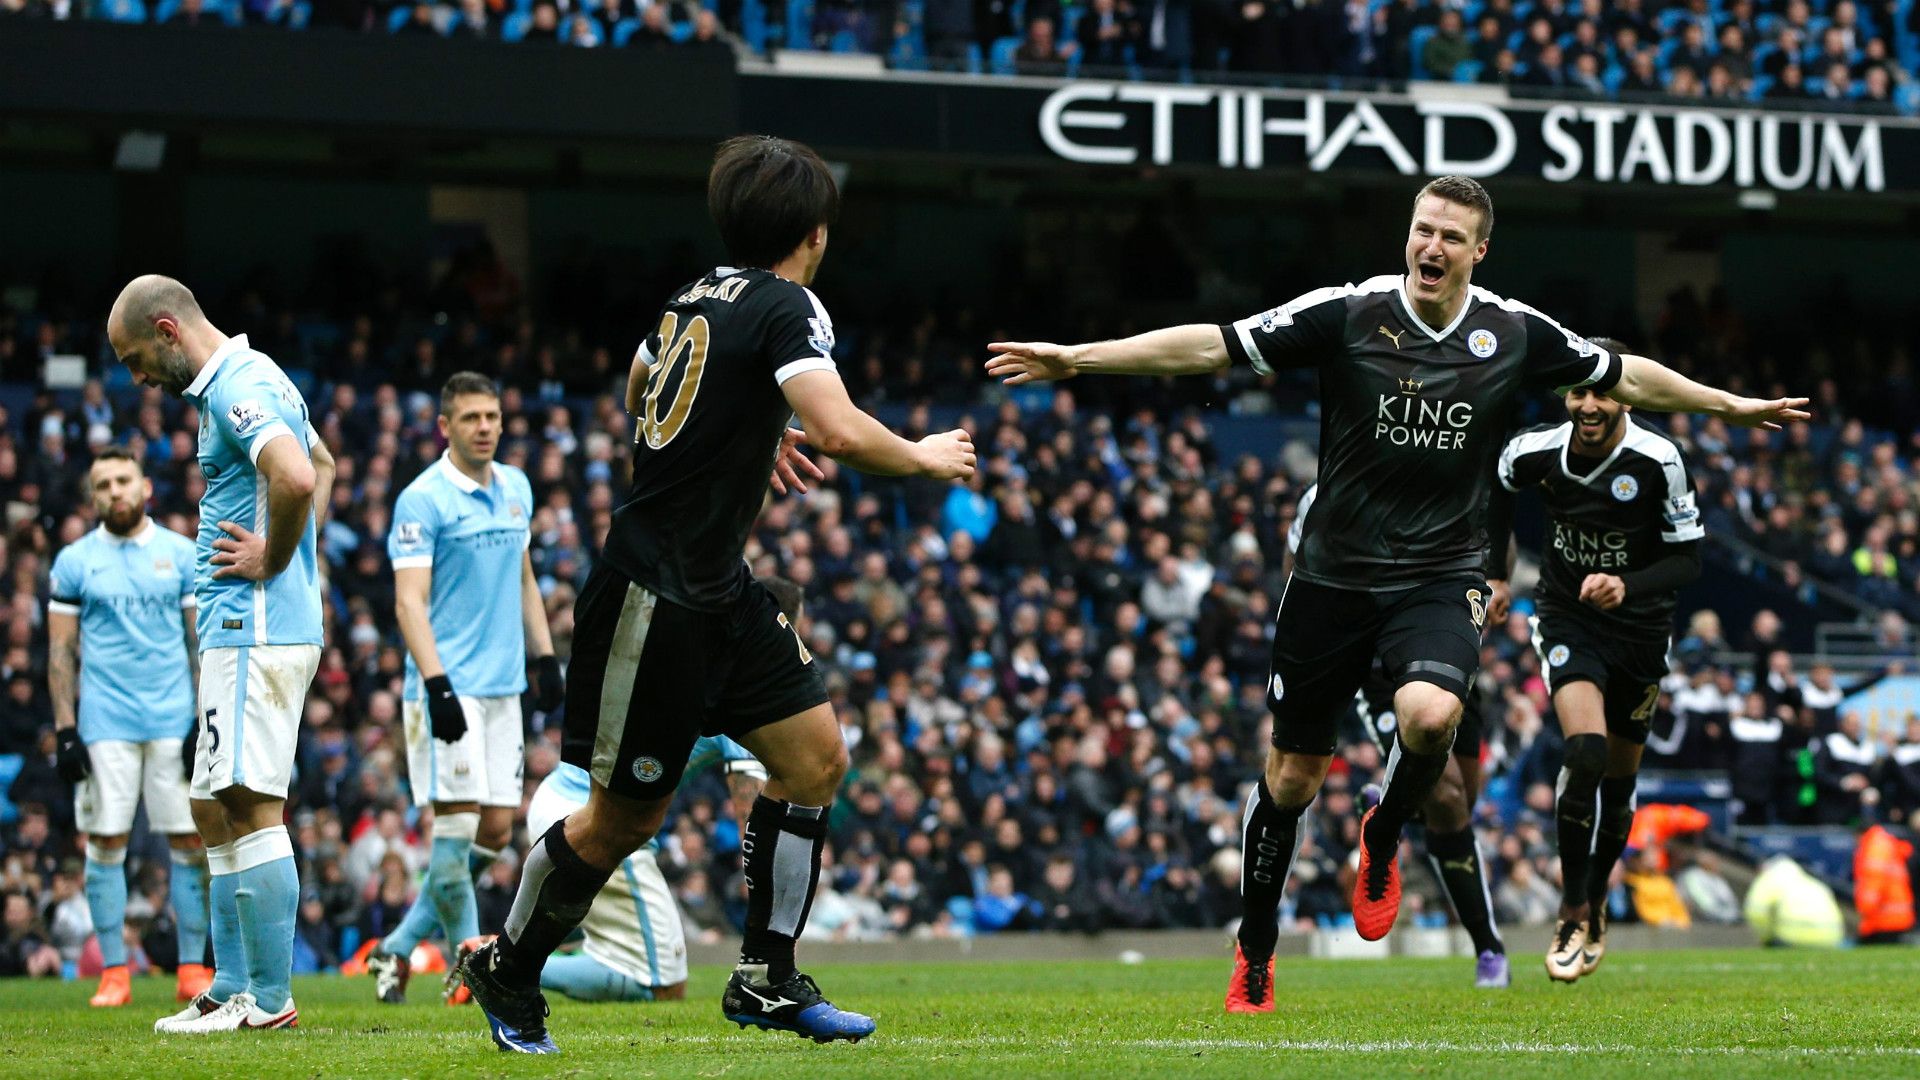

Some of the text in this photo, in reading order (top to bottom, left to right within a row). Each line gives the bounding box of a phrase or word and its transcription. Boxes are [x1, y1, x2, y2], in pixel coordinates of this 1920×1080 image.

[1038, 82, 1886, 192] ETIHAD STADIUM
[1377, 393, 1473, 428] KING
[1374, 422, 1467, 450] POWER
[1553, 537, 1628, 568] POWER
[1465, 588, 1484, 626] 6
[206, 708, 220, 755] 5
